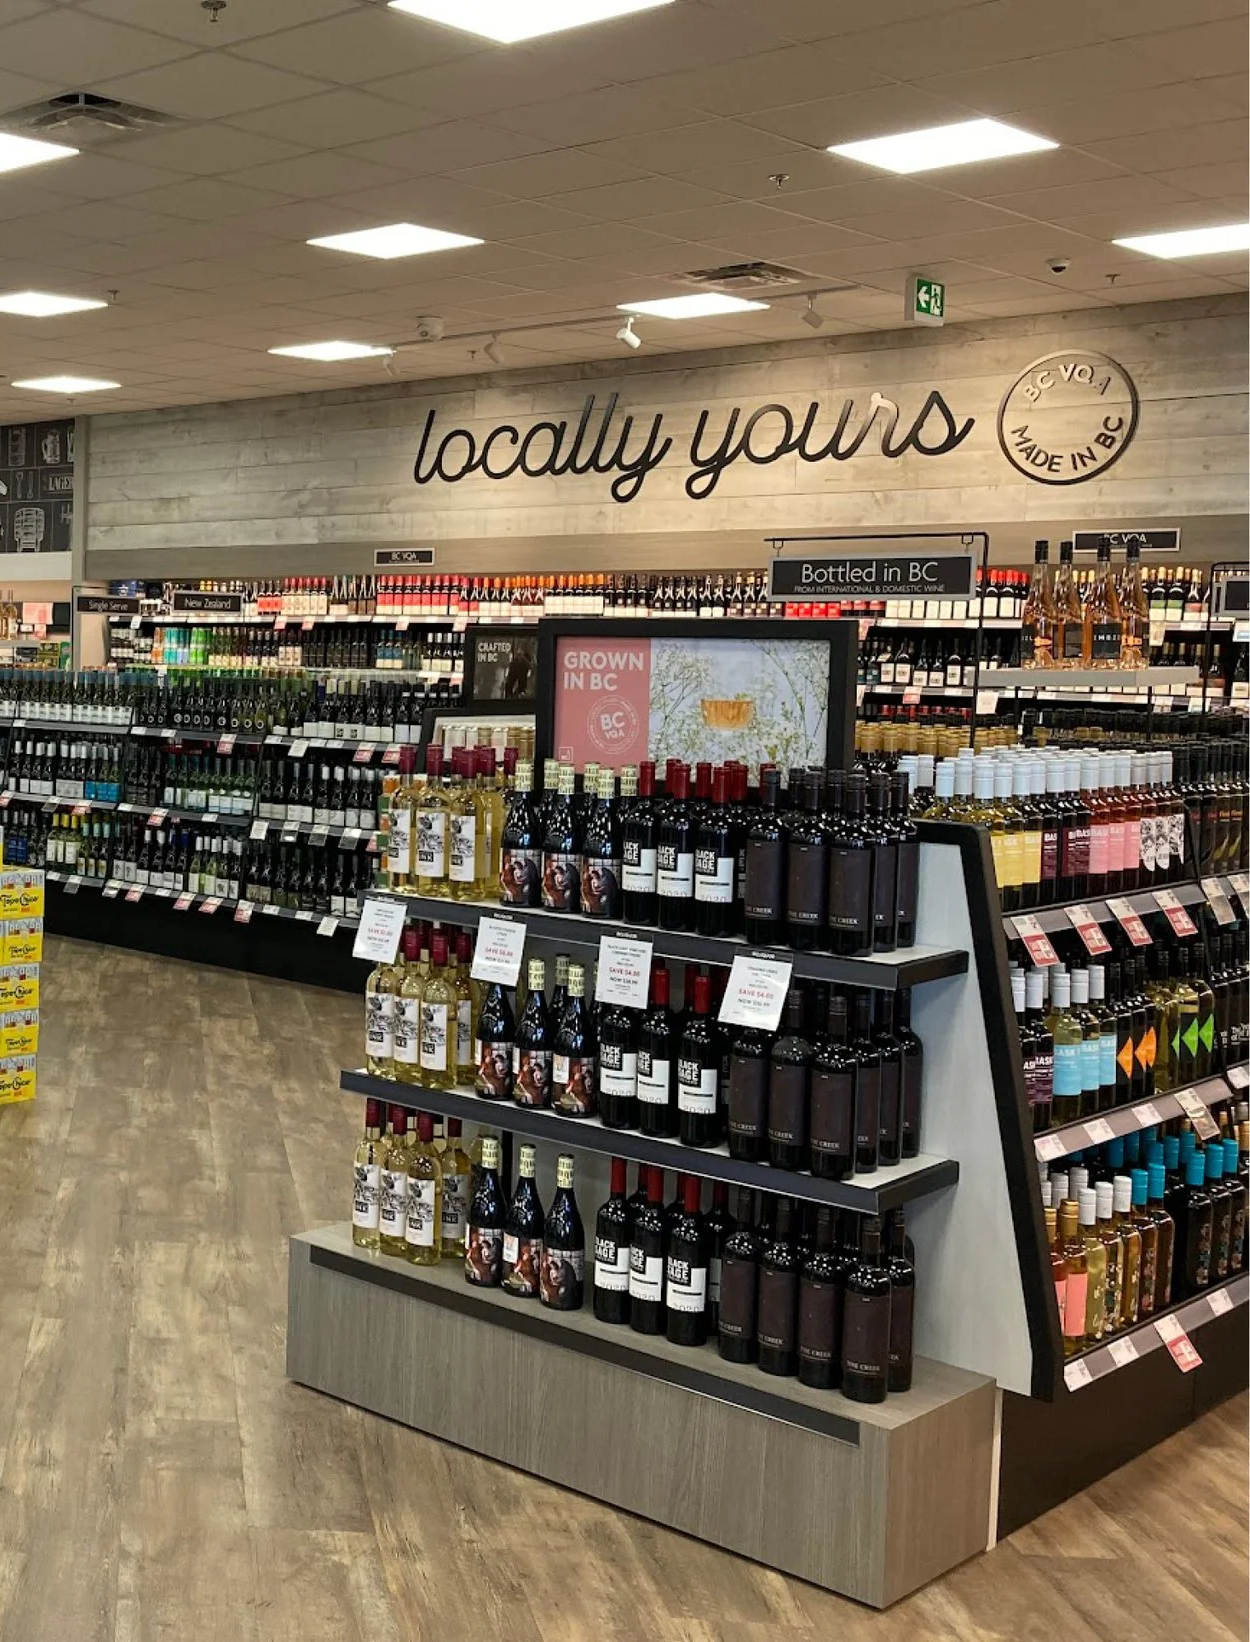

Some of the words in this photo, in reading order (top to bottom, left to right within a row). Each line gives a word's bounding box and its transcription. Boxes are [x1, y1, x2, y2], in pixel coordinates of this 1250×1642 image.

[1023, 371, 1056, 403] BC
[1058, 363, 1112, 396] VQA
[414, 392, 673, 503] locally
[685, 391, 976, 500] yours
[1011, 425, 1064, 472] MADE
[1070, 446, 1098, 471] IN
[1094, 416, 1124, 449] BC
[801, 561, 876, 583] Bottled
[883, 563, 901, 583] in
[908, 562, 938, 582] BC
[816, 585, 874, 593] INTERNATIONAL
[882, 584, 922, 593] DOMESTIC
[924, 584, 946, 592] WINE
[88, 601, 107, 612] Single
[109, 602, 128, 611] Serve
[184, 599, 201, 608] New
[204, 599, 231, 609] Zealand
[477, 642, 512, 652] CRAFTED
[477, 653, 486, 662] IN
[487, 653, 498, 662] BC
[564, 651, 644, 671] GROWN
[563, 672, 584, 690] IN
[590, 673, 618, 691] BC
[600, 712, 626, 730] BC
